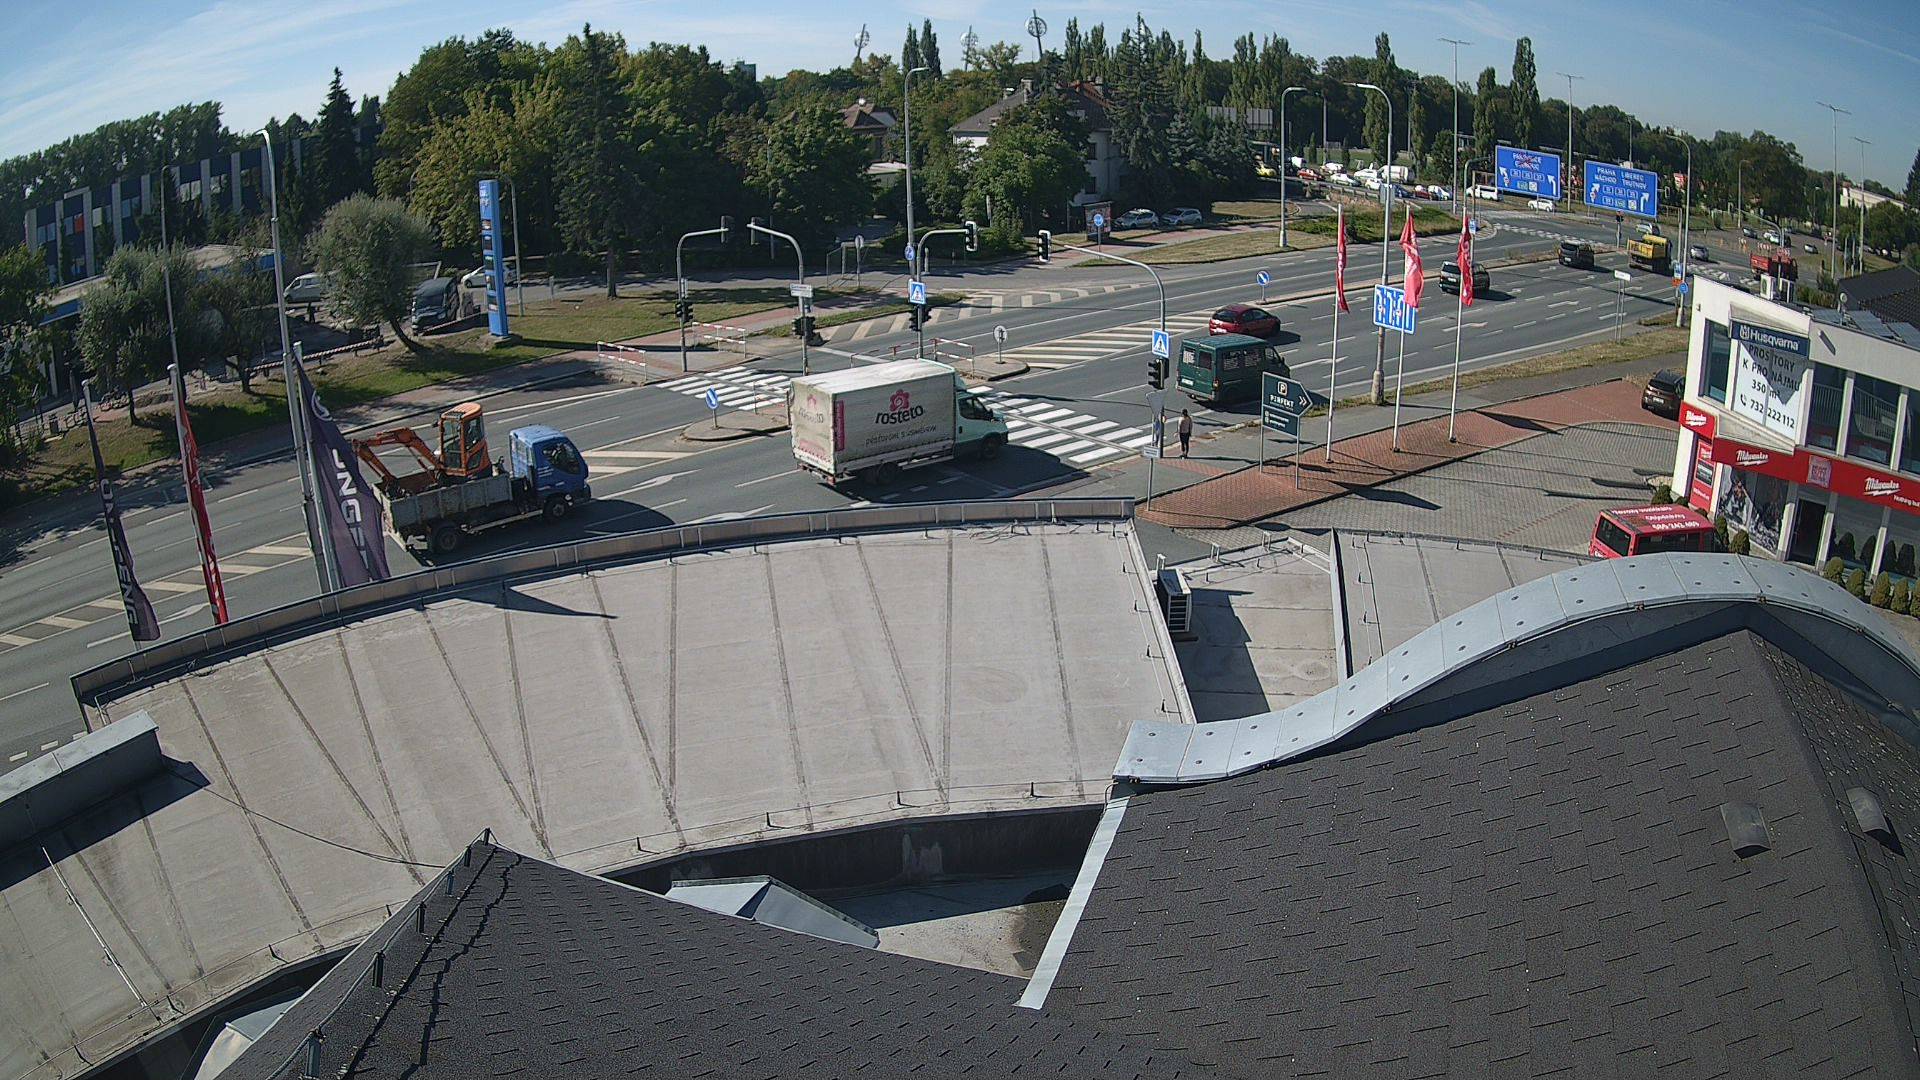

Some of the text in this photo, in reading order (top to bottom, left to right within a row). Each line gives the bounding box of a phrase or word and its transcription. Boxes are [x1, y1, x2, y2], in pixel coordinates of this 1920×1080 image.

[1751, 329, 1799, 351] Husqvarna
[1743, 358, 1749, 369] K
[1752, 379, 1766, 394] 350
[1750, 399, 1764, 414] 732
[875, 404, 924, 425] rosteto
